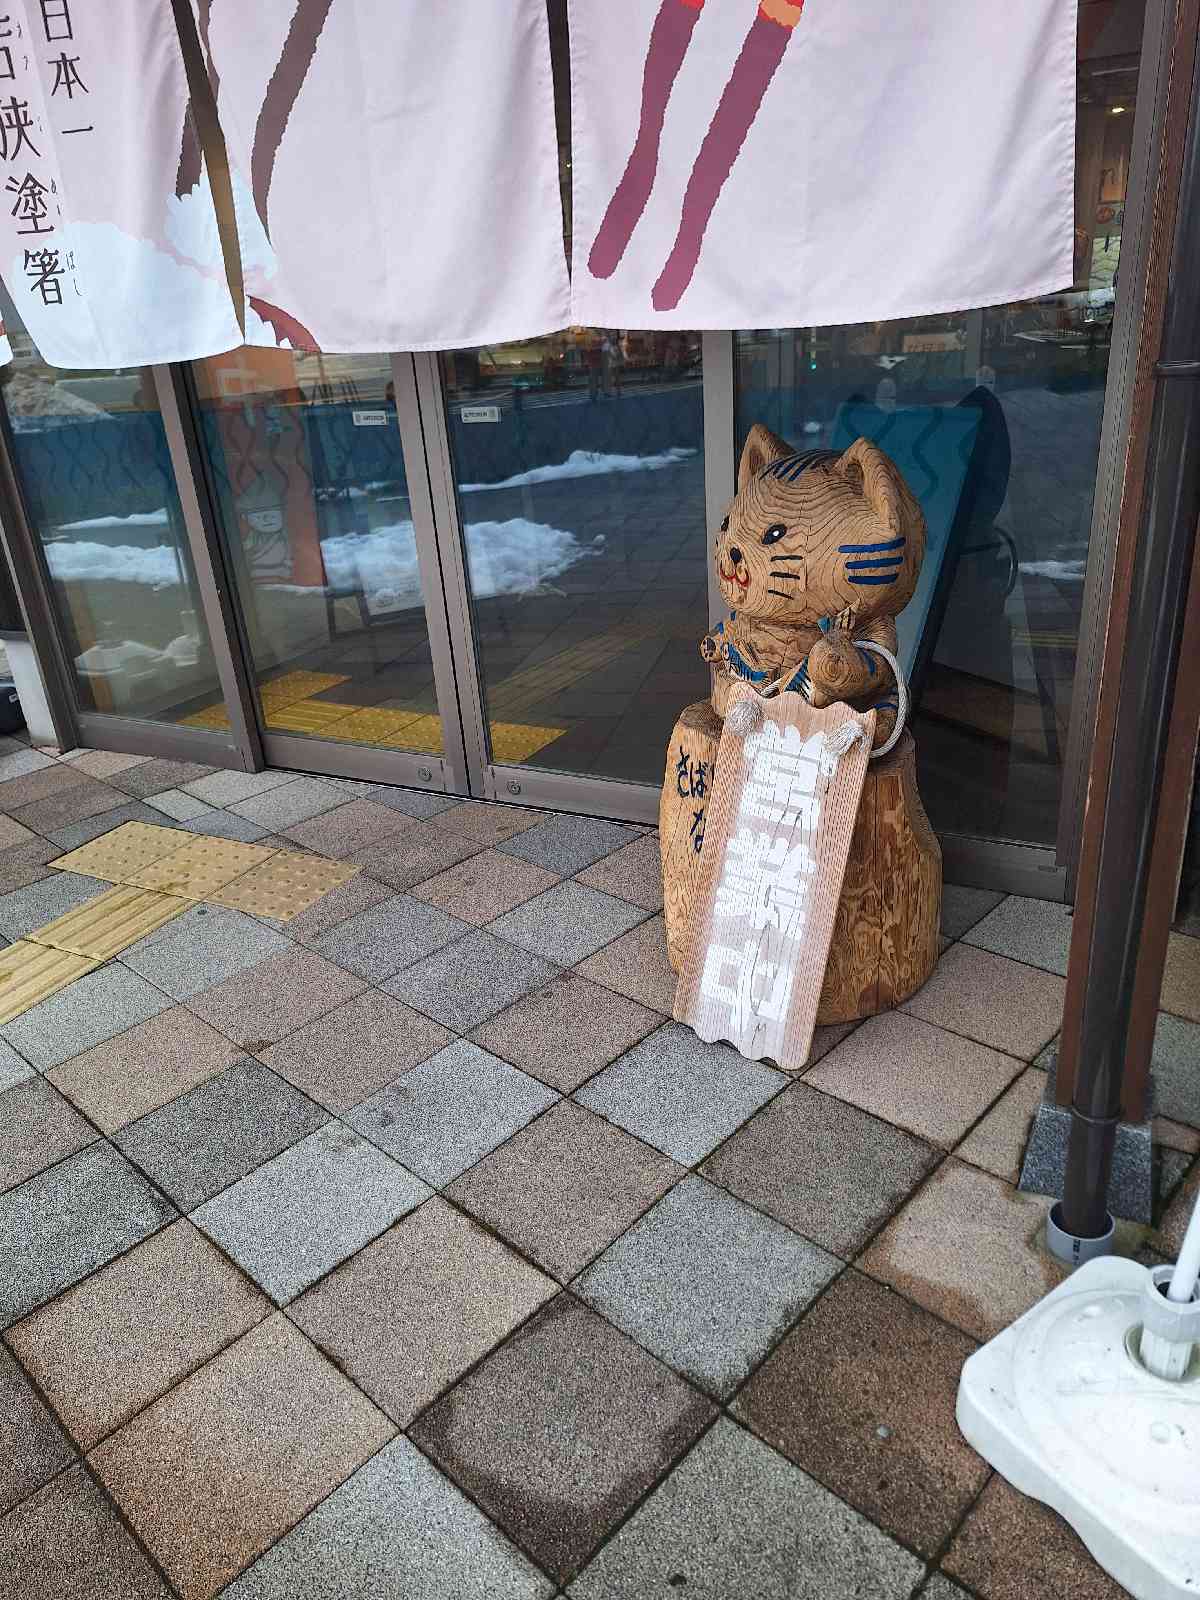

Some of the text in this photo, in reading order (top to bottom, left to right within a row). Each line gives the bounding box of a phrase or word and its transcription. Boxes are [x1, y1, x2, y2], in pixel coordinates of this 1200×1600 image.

[40, 0, 95, 136] 日本一
[677, 745, 714, 798] さば
[699, 719, 838, 1034] 営業中
